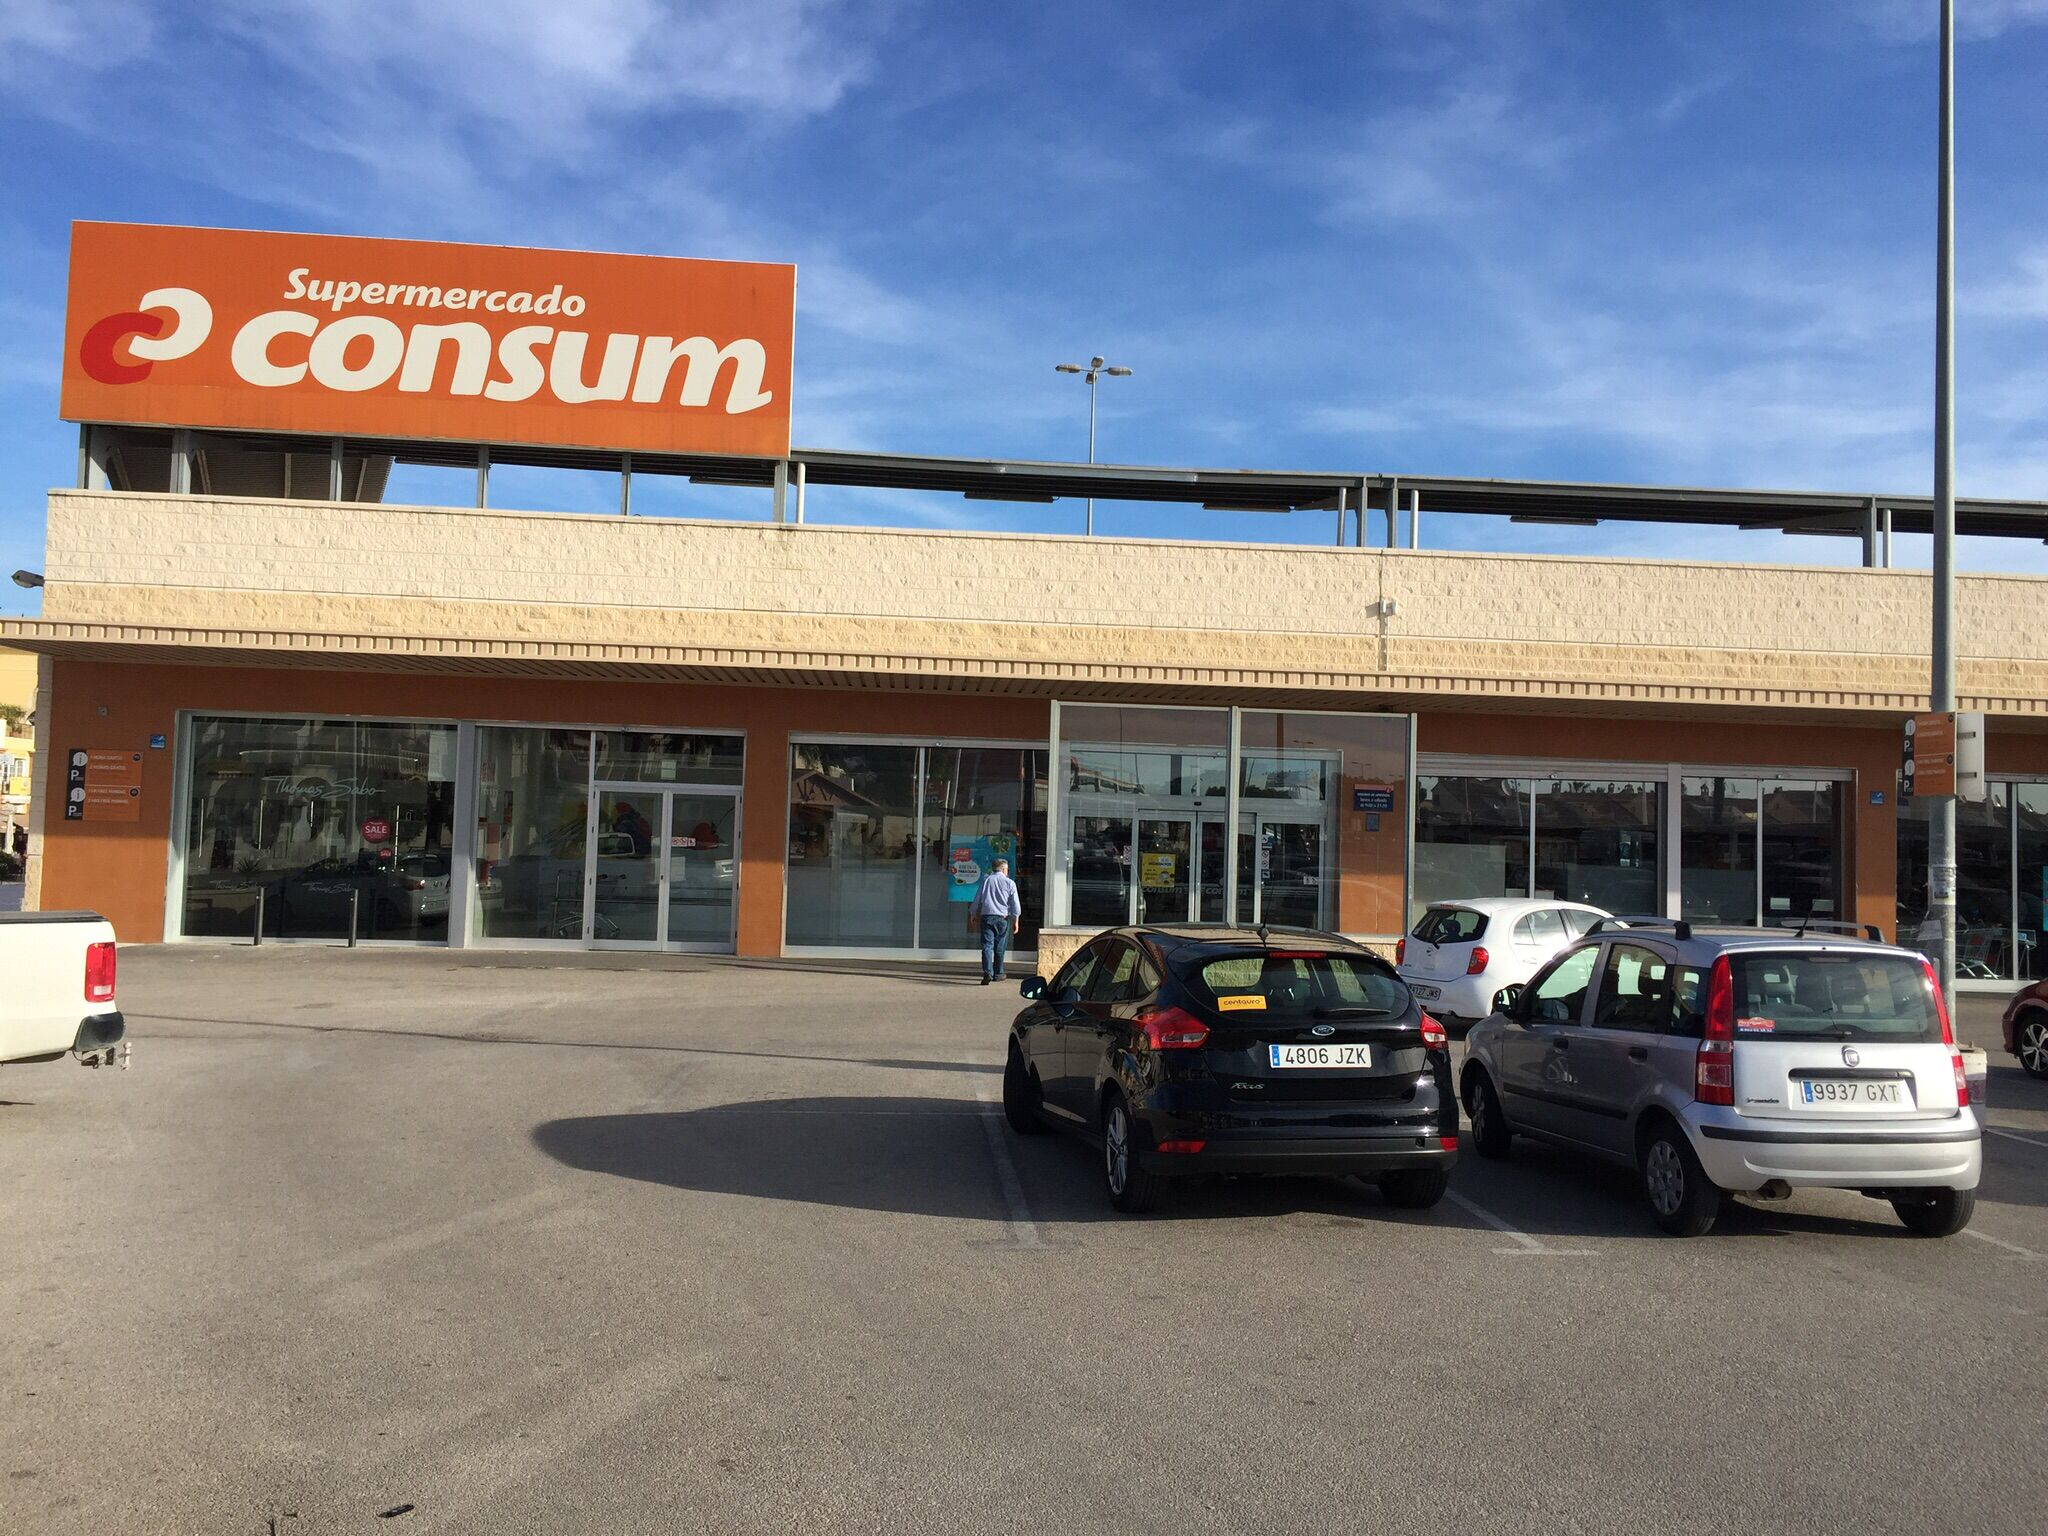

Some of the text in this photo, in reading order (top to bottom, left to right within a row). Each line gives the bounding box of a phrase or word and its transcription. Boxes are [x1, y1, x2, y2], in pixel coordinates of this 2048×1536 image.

[284, 268, 586, 318] Supermercado
[231, 310, 773, 414] consum
[321, 776, 386, 799] Sabo
[365, 825, 388, 834] SALE
[1223, 998, 1261, 1007] centauro
[1285, 1047, 1366, 1064] 4806 JZK
[1814, 1084, 1898, 1102] 9937 GXT
